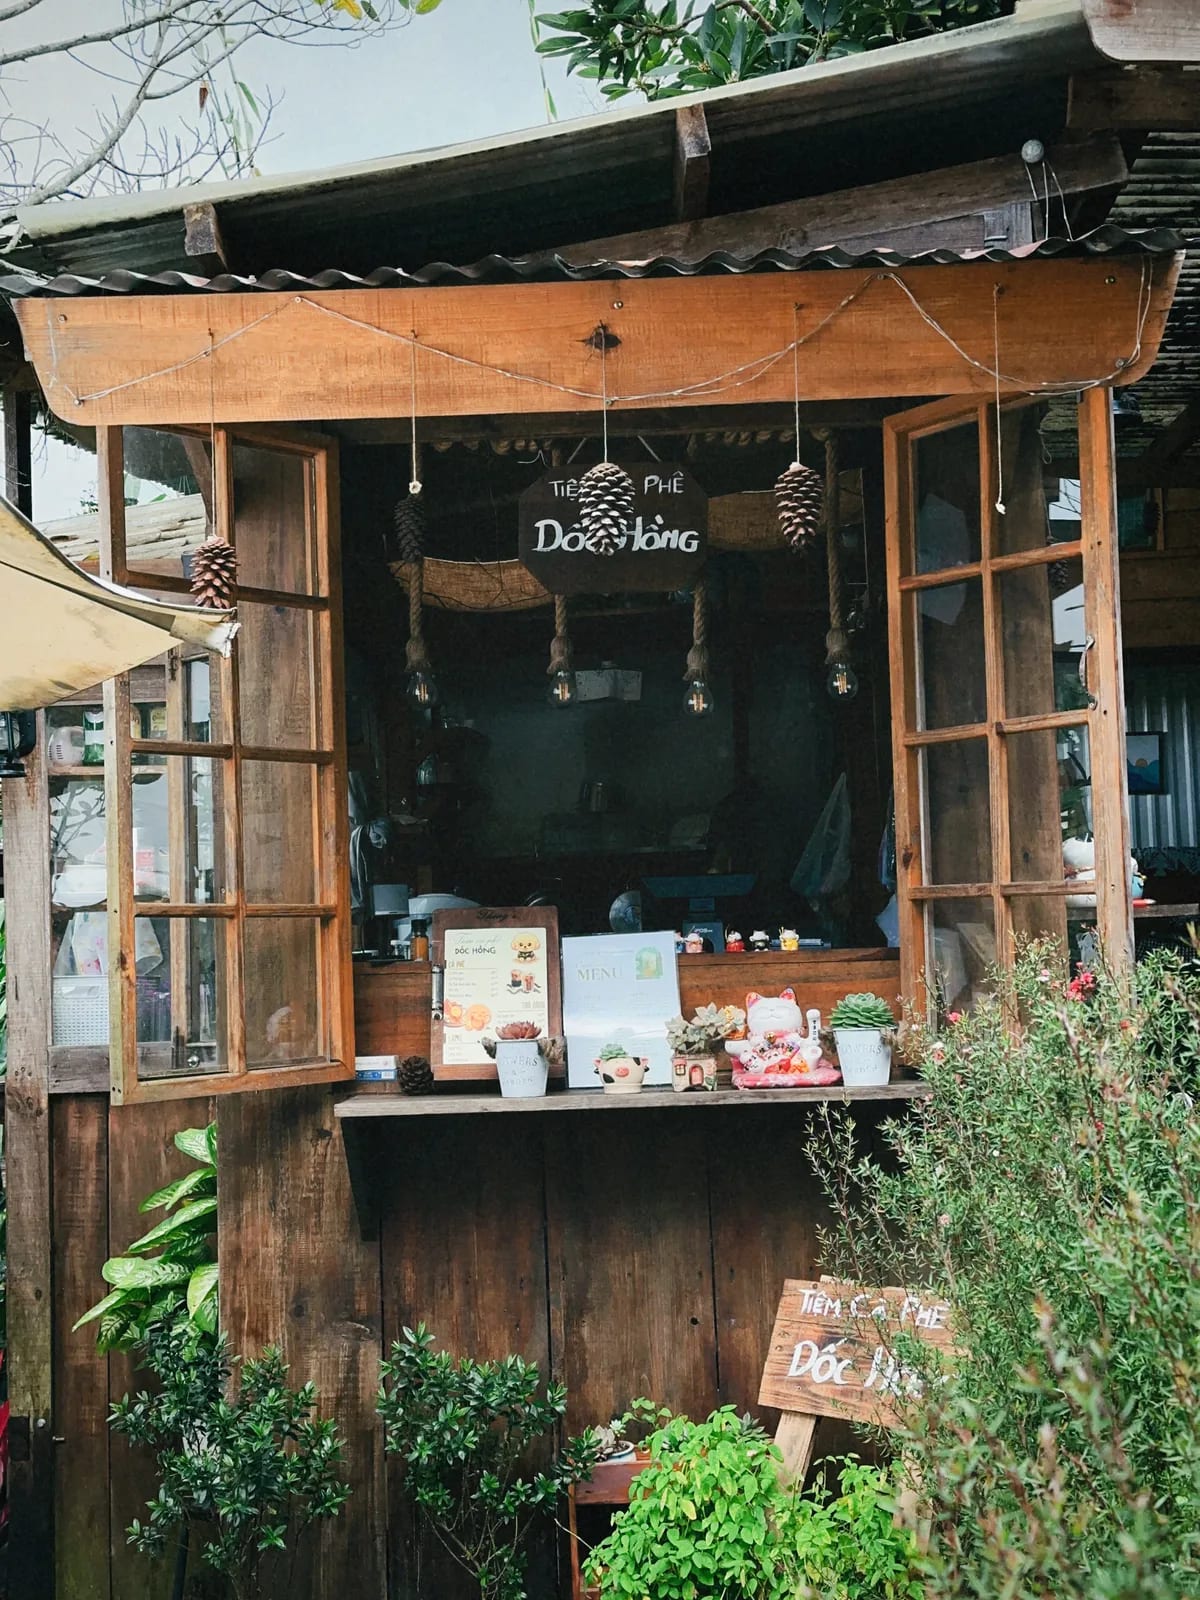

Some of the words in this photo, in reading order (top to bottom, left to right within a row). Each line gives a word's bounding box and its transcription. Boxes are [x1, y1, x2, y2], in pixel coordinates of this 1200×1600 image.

[548, 478, 583, 501] TIỆ
[644, 470, 684, 495] PHÊ
[576, 966, 624, 982] MENU
